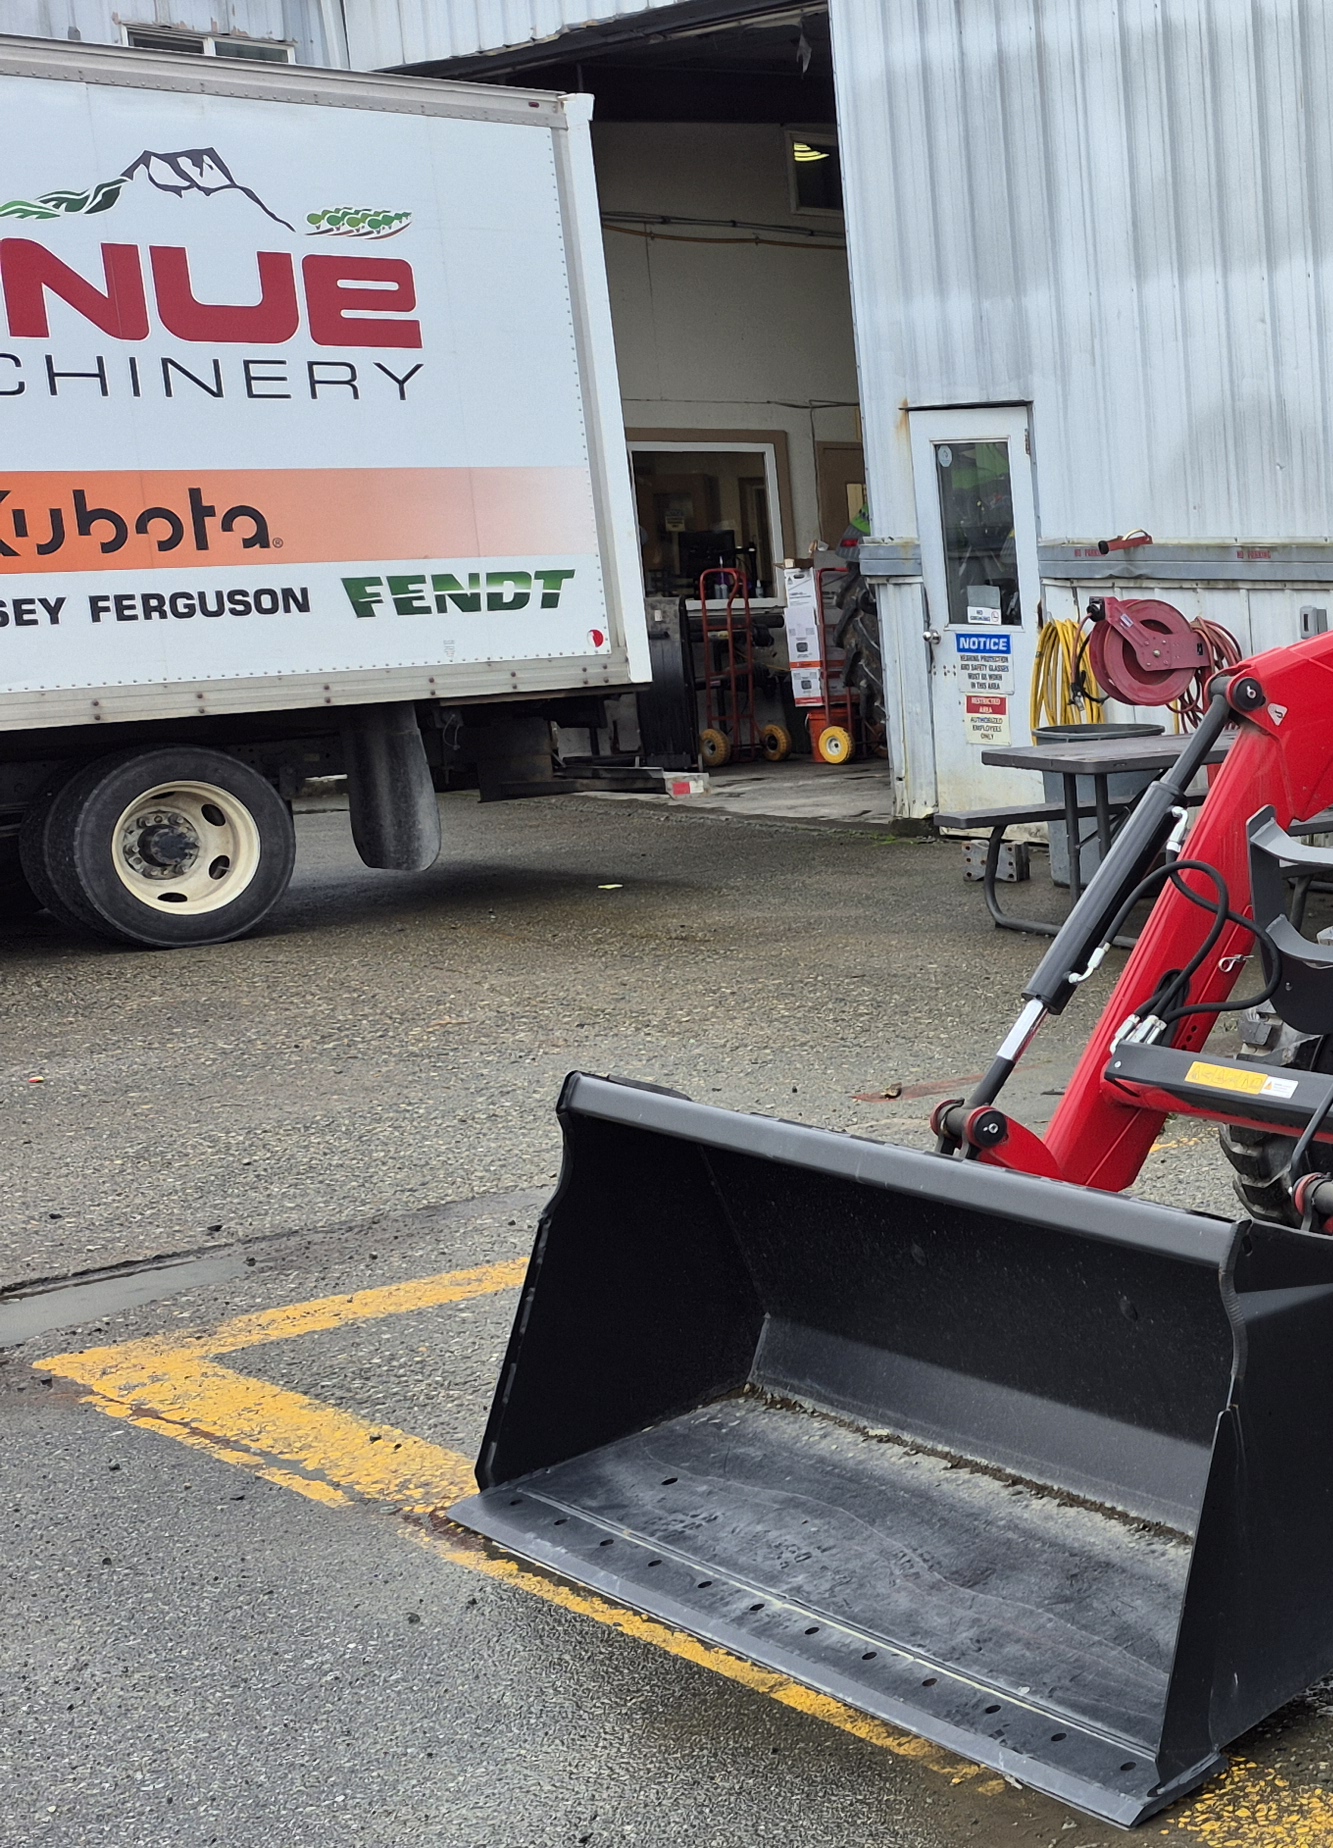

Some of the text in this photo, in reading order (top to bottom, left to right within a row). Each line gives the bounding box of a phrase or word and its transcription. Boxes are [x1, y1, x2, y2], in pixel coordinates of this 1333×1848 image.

[88, 588, 310, 623] FERGUSON
[341, 569, 575, 619] FENDT
[960, 637, 1008, 651] NOTICE
